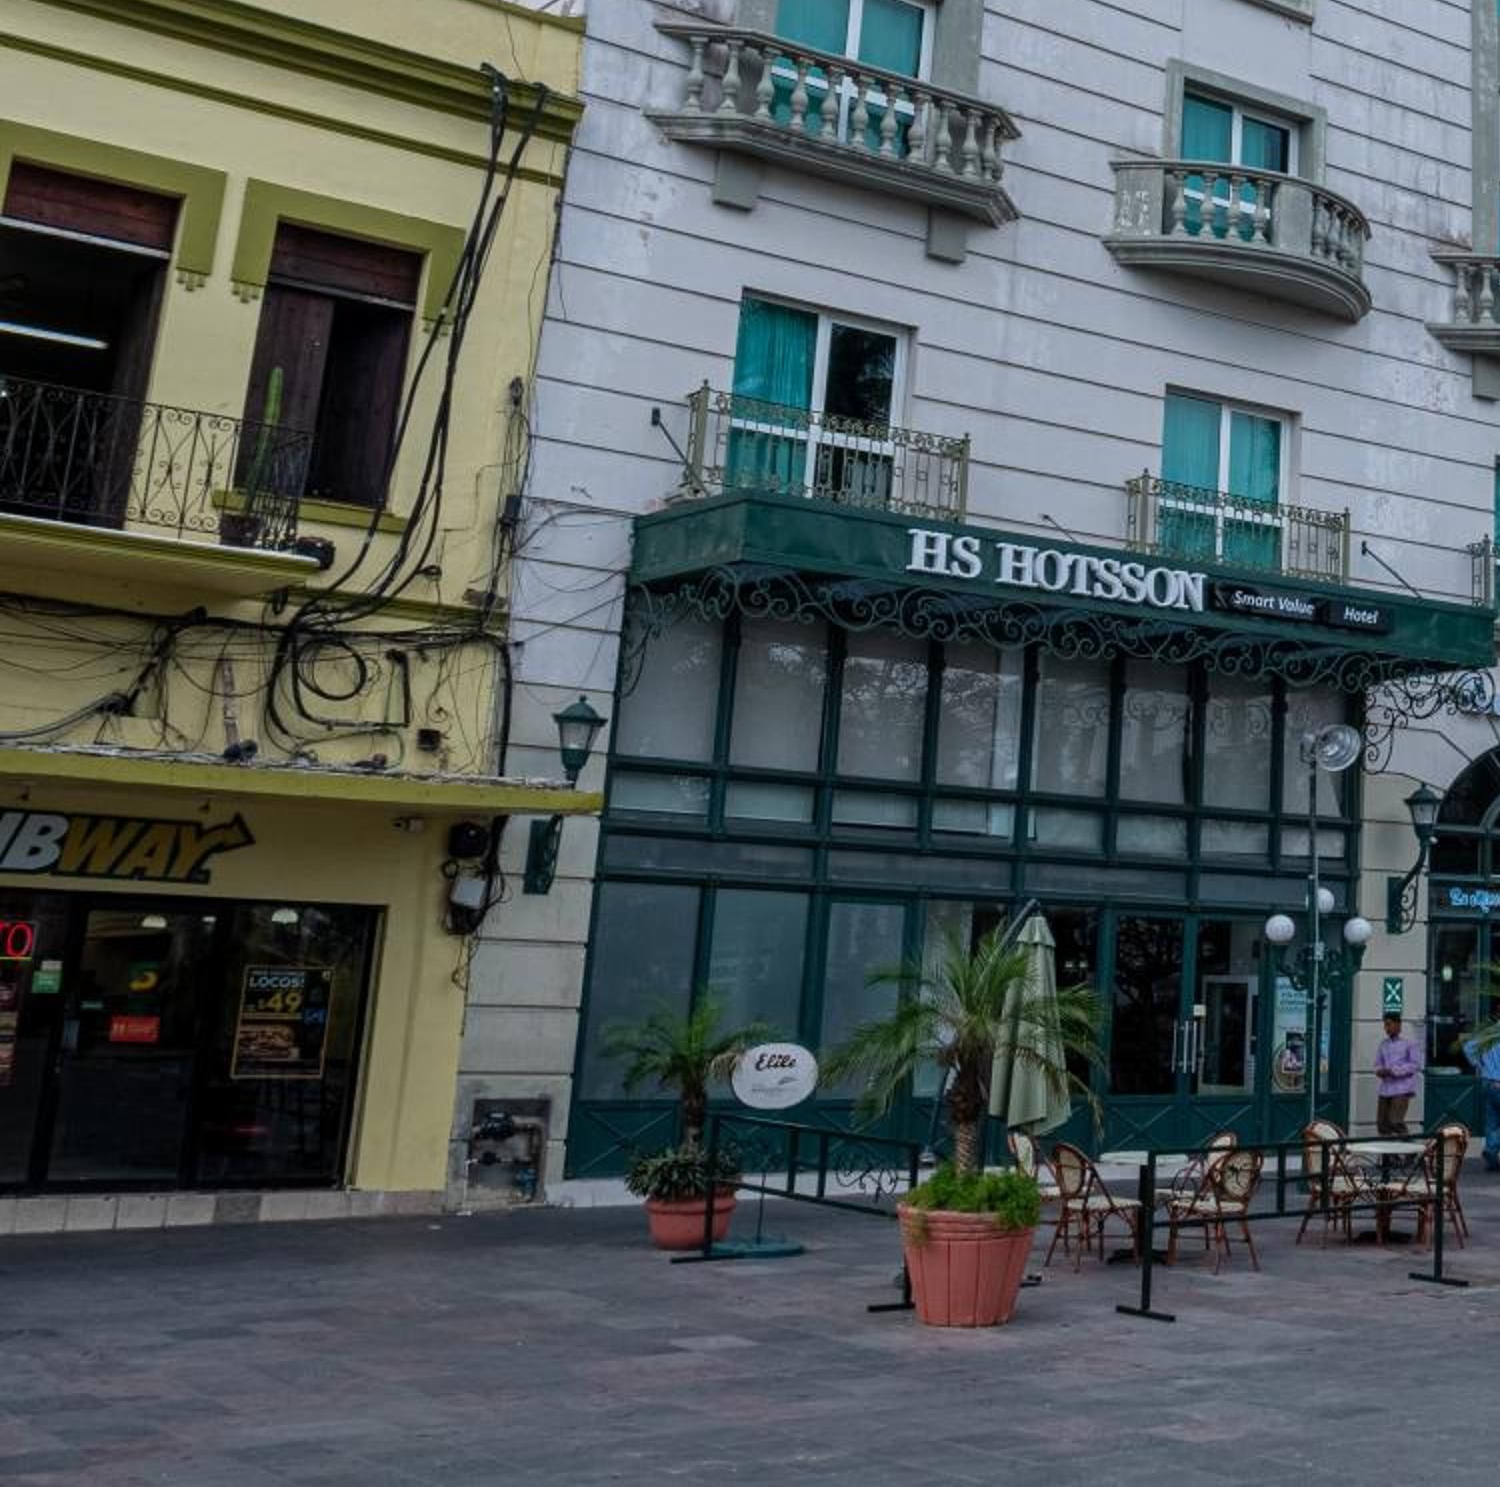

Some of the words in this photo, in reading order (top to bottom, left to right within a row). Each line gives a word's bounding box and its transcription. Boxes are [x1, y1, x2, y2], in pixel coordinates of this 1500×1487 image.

[905, 528, 982, 578] HS
[995, 543, 1207, 611] HOTSSON
[1233, 590, 1274, 609] Smart
[1278, 598, 1315, 616] Value
[1344, 607, 1379, 624] Hotel
